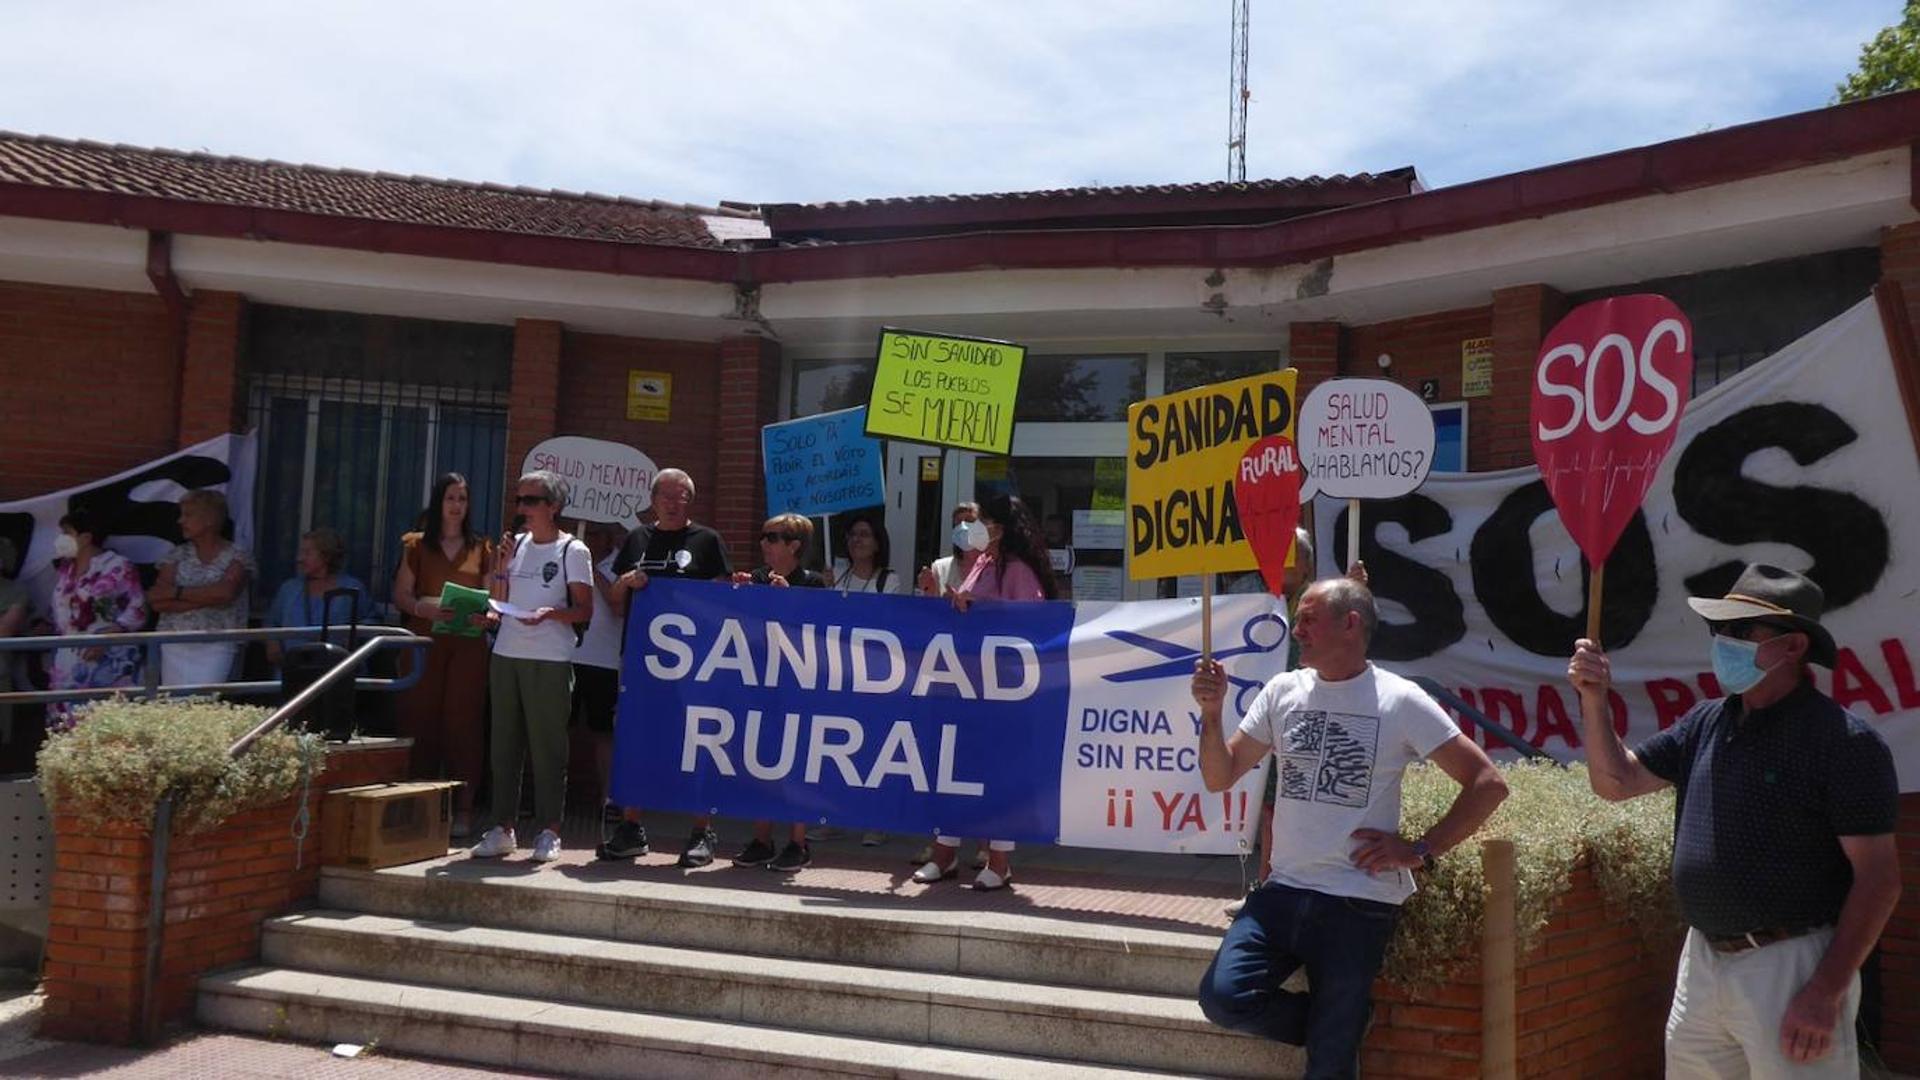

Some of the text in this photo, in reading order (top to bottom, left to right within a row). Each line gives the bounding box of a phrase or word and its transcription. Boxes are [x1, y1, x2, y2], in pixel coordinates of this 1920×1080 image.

[932, 342, 1003, 367] SANIDAD
[904, 370, 991, 396] LOS PUEBLOS
[1424, 382, 1434, 398] 2
[1537, 319, 1686, 441] SOS
[883, 391, 1000, 446] SE MUEREN
[1327, 392, 1388, 420] SALUD
[1135, 383, 1291, 469] SANIDAD
[1318, 421, 1395, 448] MENTAL
[772, 430, 816, 455] SOLO
[534, 452, 585, 479] SALUD
[1242, 445, 1299, 485] RURAL
[1310, 450, 1425, 479] ¿HABLAMOS?
[1132, 480, 1246, 557] DIGNA
[1333, 401, 1890, 662] SOS
[644, 612, 1041, 702] SANIDAD
[1081, 708, 1172, 735] DIGNA
[680, 705, 985, 797] RURAL
[1077, 743, 1123, 769] SIN
[1152, 790, 1207, 831] YA
[1222, 791, 1248, 831] !!
